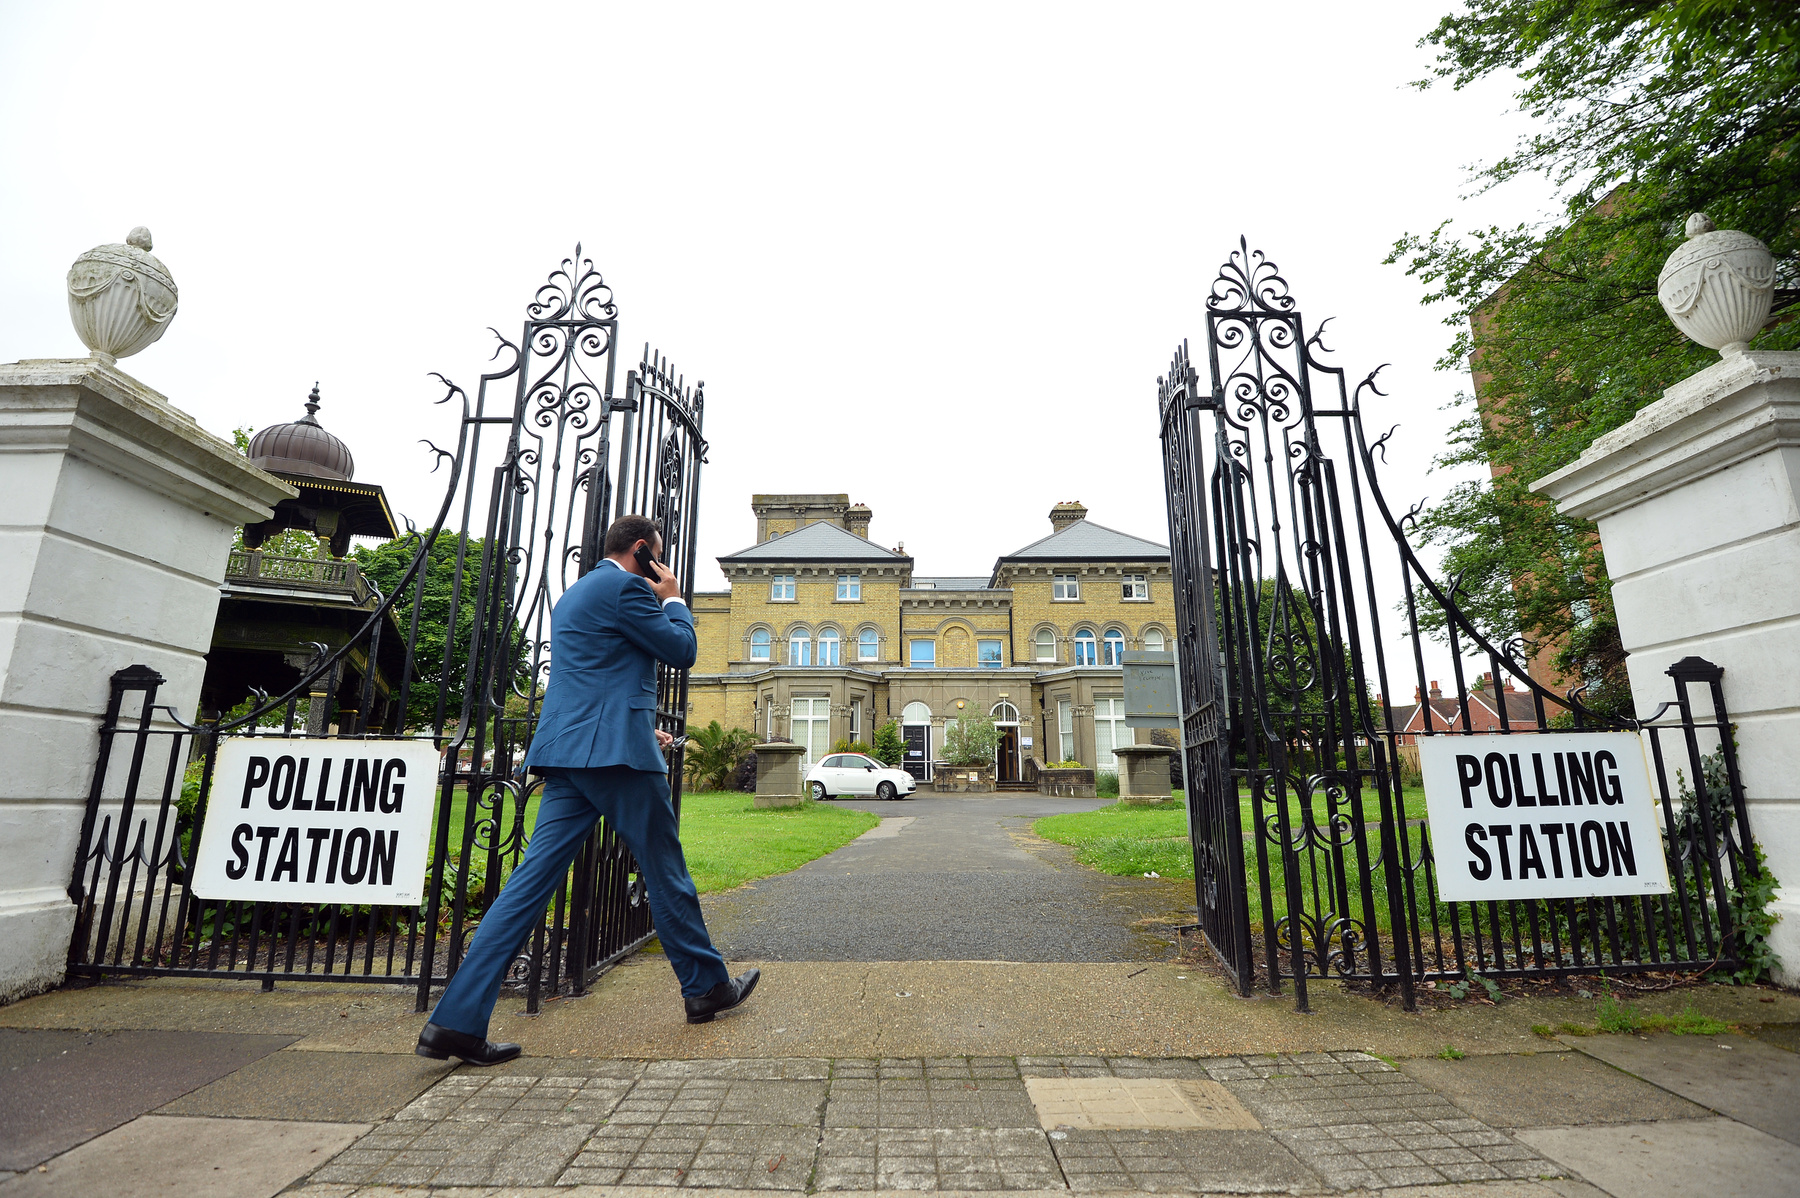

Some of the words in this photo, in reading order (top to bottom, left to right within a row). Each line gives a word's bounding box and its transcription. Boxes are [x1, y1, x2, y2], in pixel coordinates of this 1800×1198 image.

[240, 754, 407, 814] POLLING
[1455, 749, 1625, 809] POLLING
[225, 822, 399, 886] STATION
[1464, 819, 1638, 881] STATION
